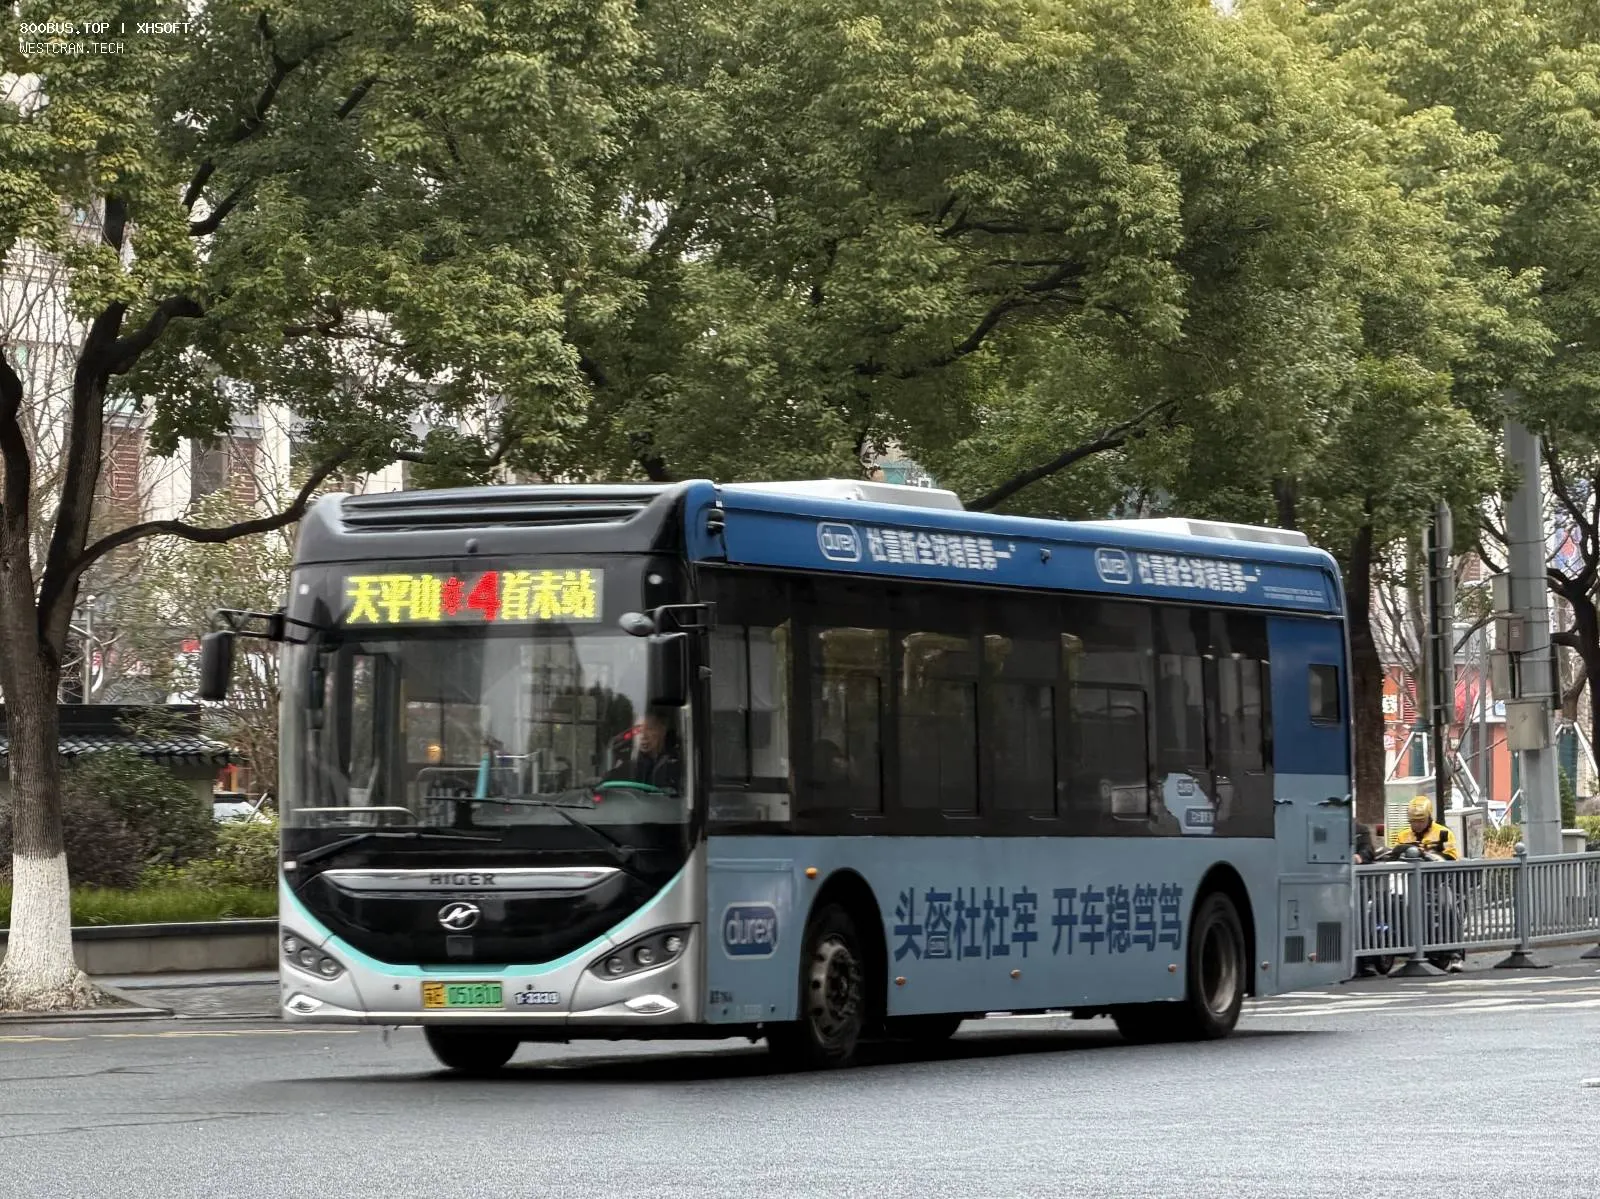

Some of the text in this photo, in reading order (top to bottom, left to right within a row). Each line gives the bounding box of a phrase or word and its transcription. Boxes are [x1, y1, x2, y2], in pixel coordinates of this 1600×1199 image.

[430, 873, 496, 885] HIGER
[1051, 882, 1183, 956] 开车稳笃笃
